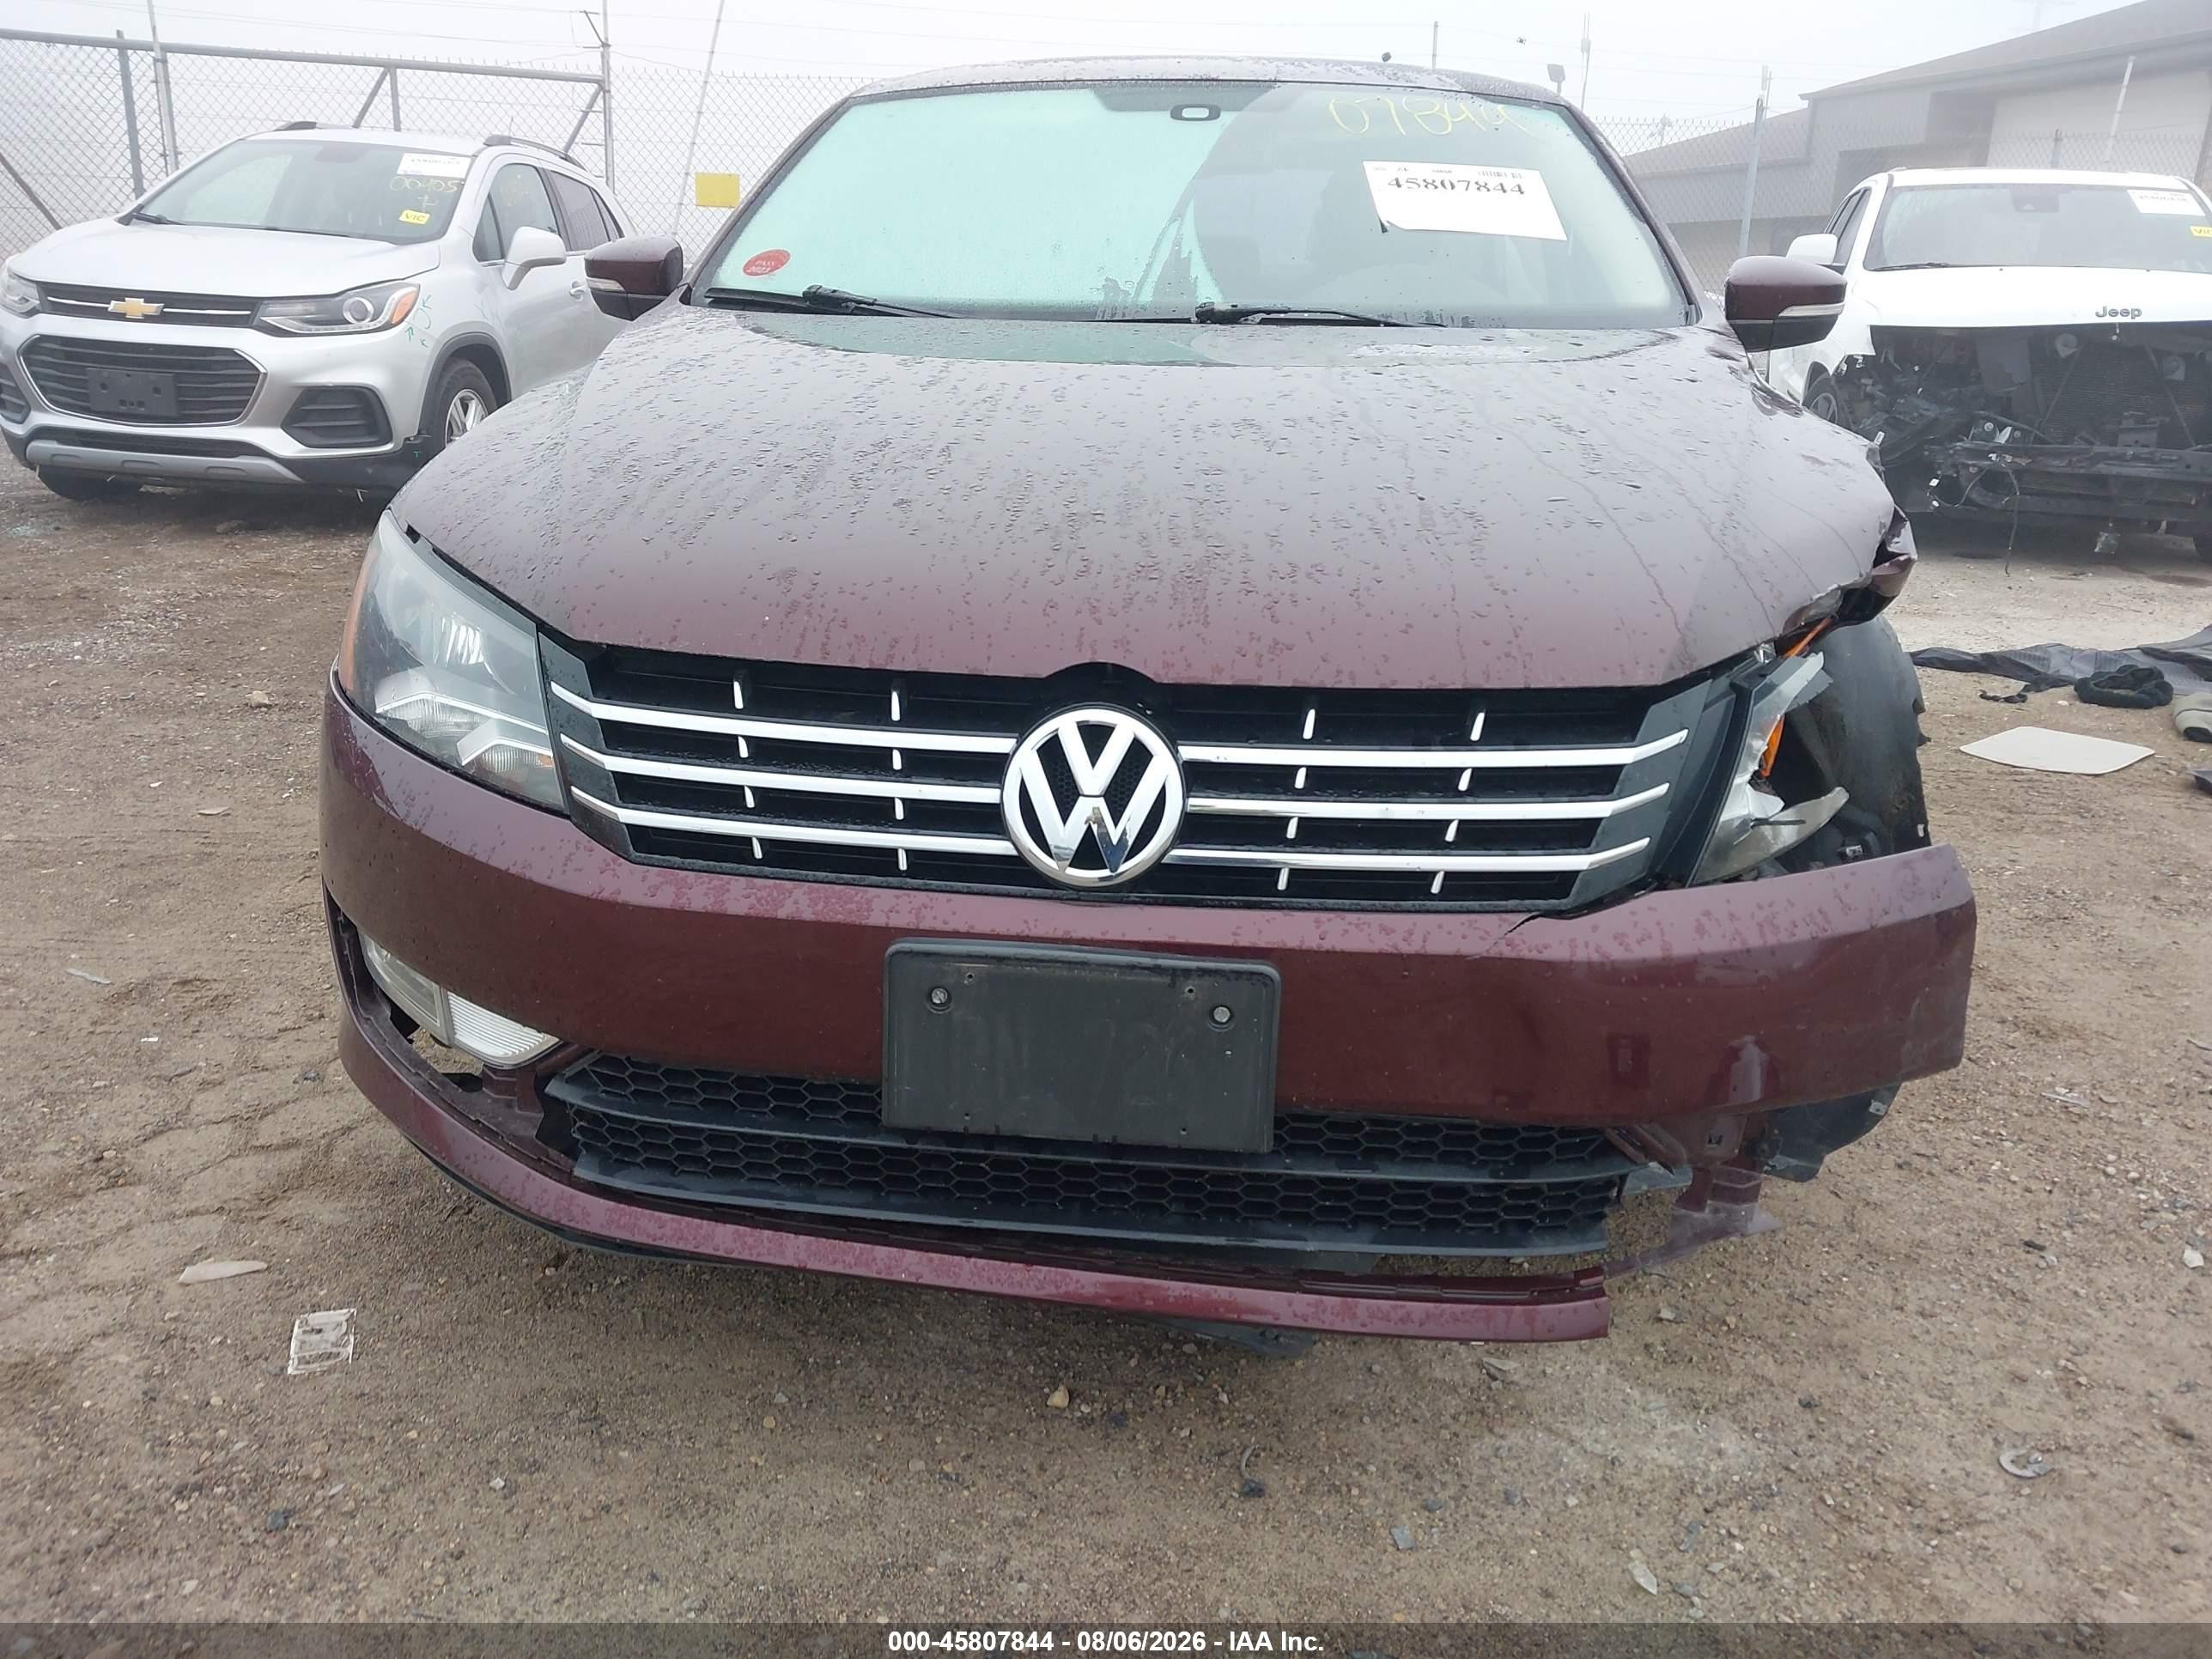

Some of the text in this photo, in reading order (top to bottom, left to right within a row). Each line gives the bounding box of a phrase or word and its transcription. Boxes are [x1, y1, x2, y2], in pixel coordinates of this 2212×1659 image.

[1388, 177, 1525, 195] 45807844
[404, 211, 426, 222] VIC
[2095, 306, 2142, 319] Jeep
